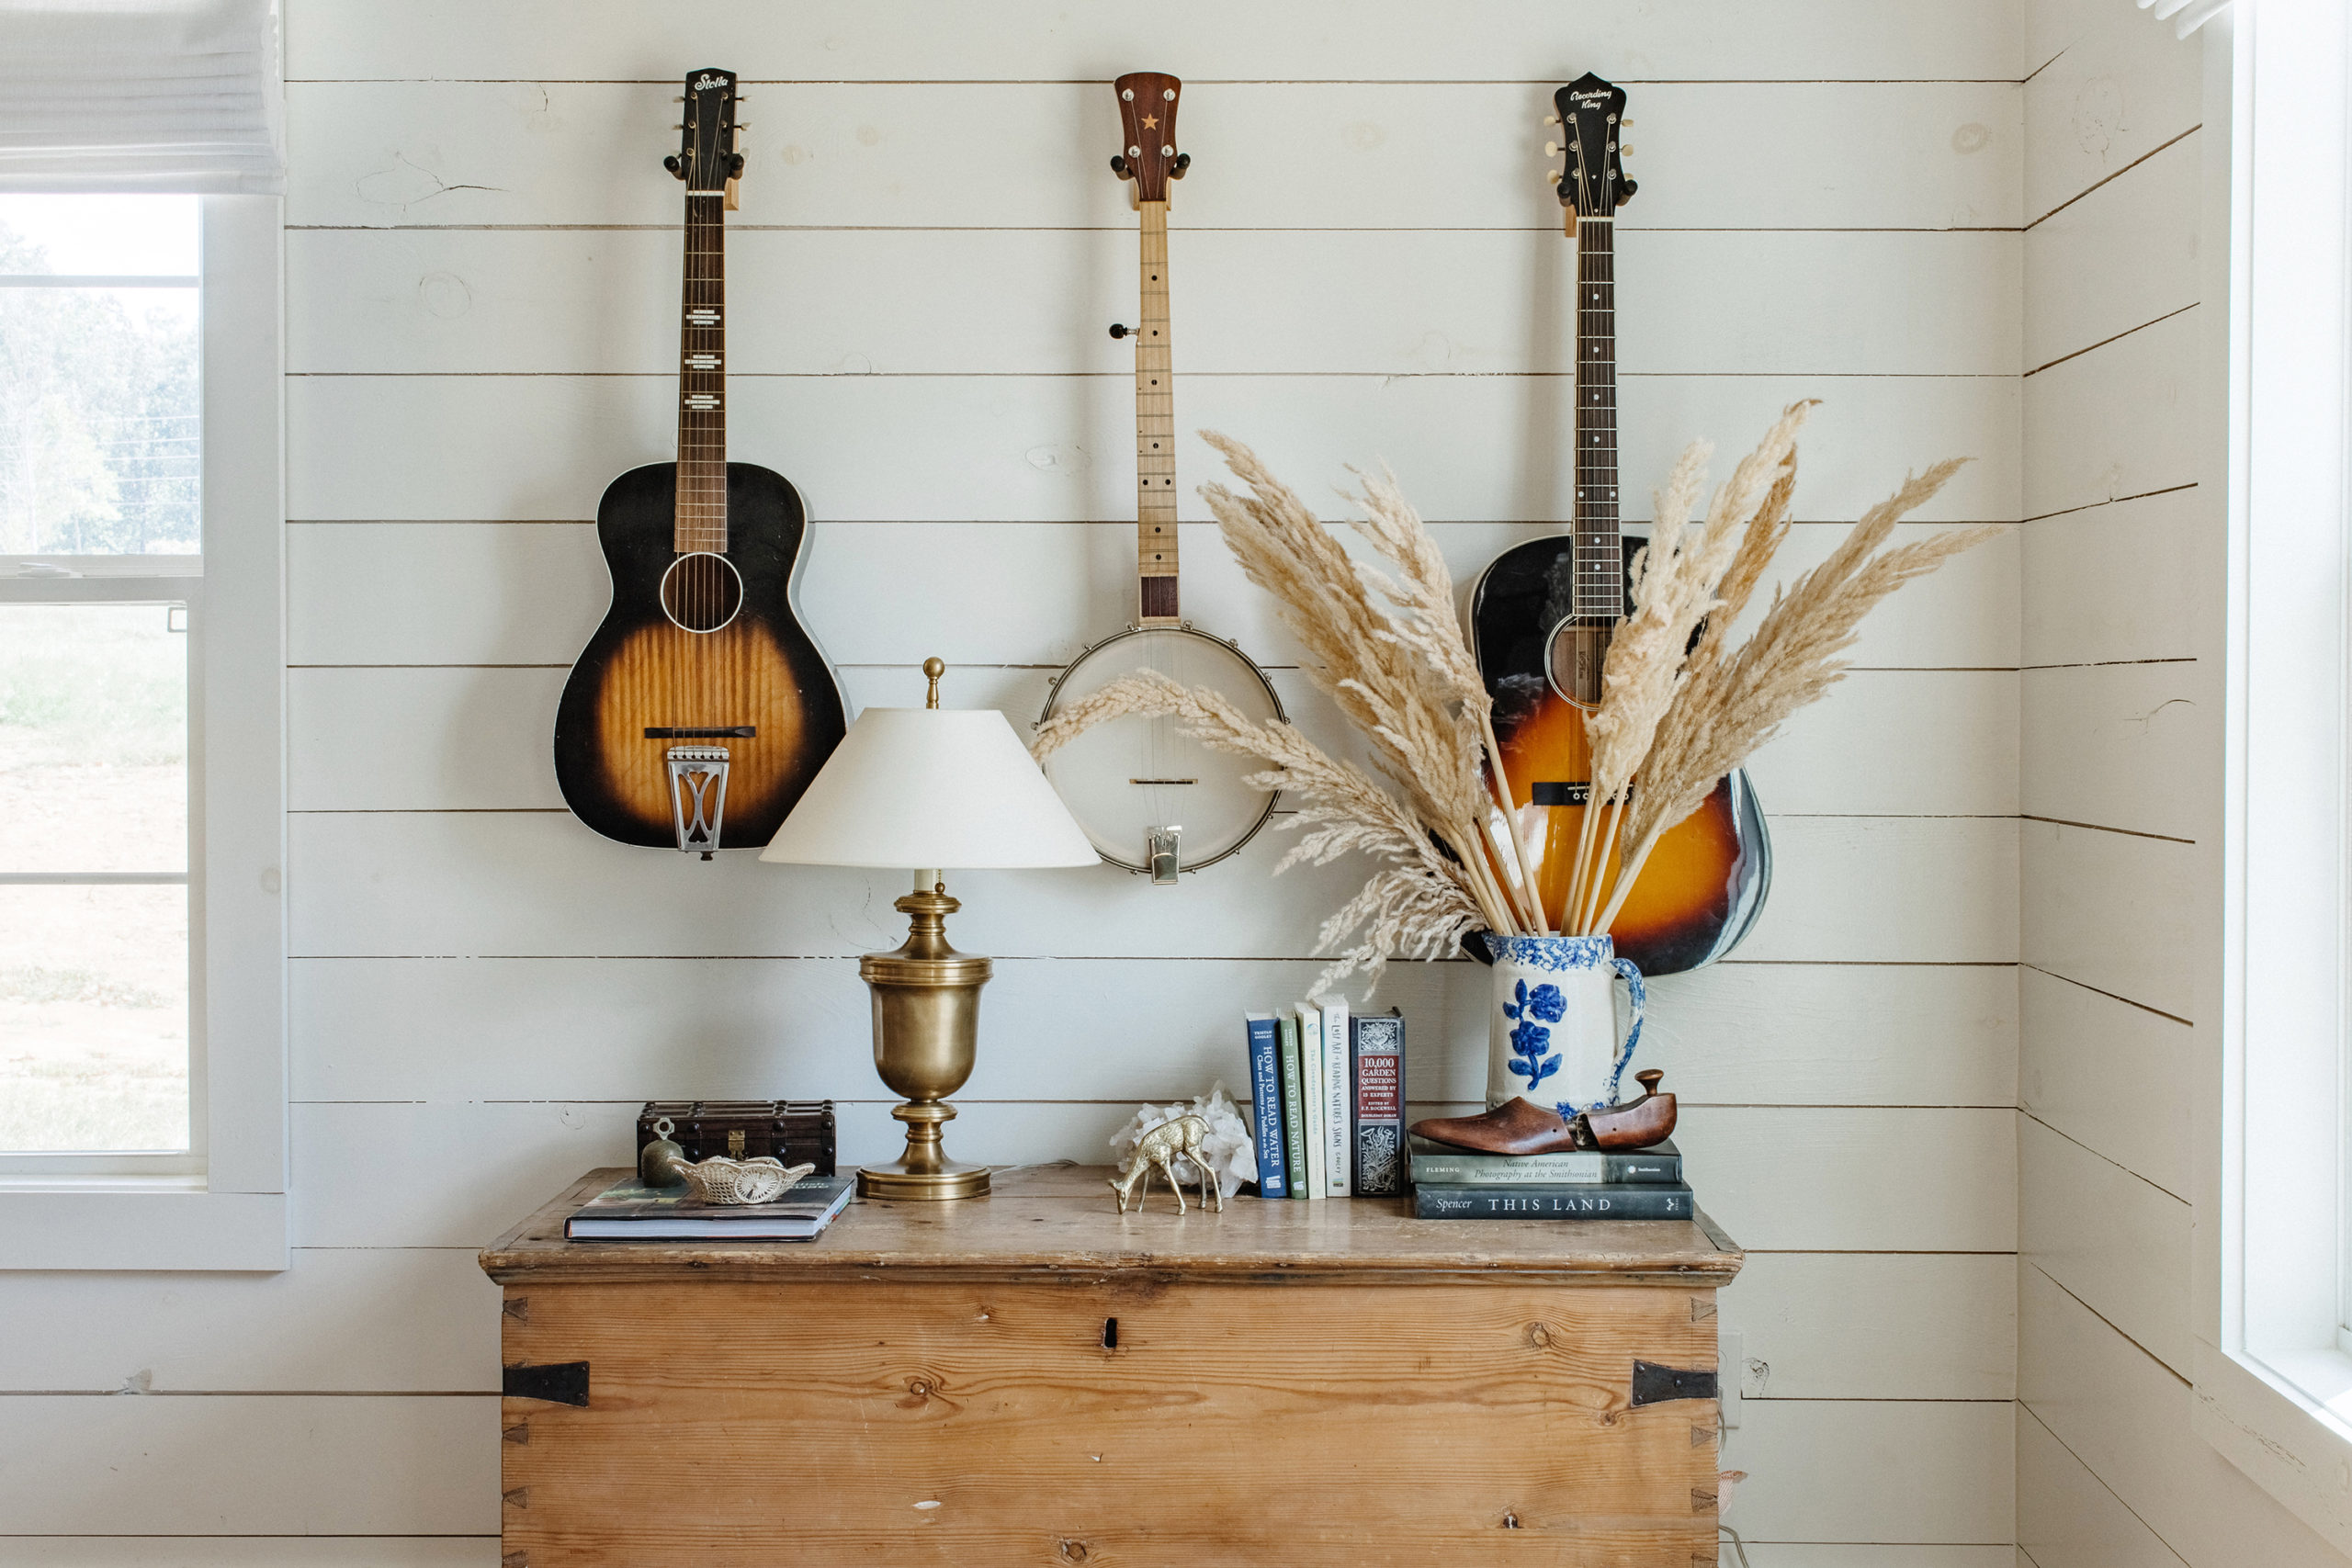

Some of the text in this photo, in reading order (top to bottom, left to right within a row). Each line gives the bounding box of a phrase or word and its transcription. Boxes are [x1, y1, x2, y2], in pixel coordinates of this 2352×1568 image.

[695, 73, 729, 91] Stella
[1570, 88, 1612, 101] Recording
[1581, 99, 1601, 110] King
[1331, 1042, 1341, 1055] ART
[1364, 1057, 1395, 1068] 10,000
[1331, 1062, 1341, 1090] READING
[1362, 1068, 1396, 1077] GARDEN
[1263, 1046, 1280, 1168] HOW TO READ WATER
[1286, 1055, 1301, 1173] HOW TO READ NATURE
[1332, 1127, 1342, 1147] SIGNS
[1502, 1159, 1569, 1168] Native American
[1475, 1168, 1522, 1180] Photography
[1534, 1169, 1547, 1178] the
[1550, 1169, 1597, 1178] Smithsonian
[1436, 1198, 1472, 1212] Spencer
[1487, 1199, 1611, 1211] THIS LAND
